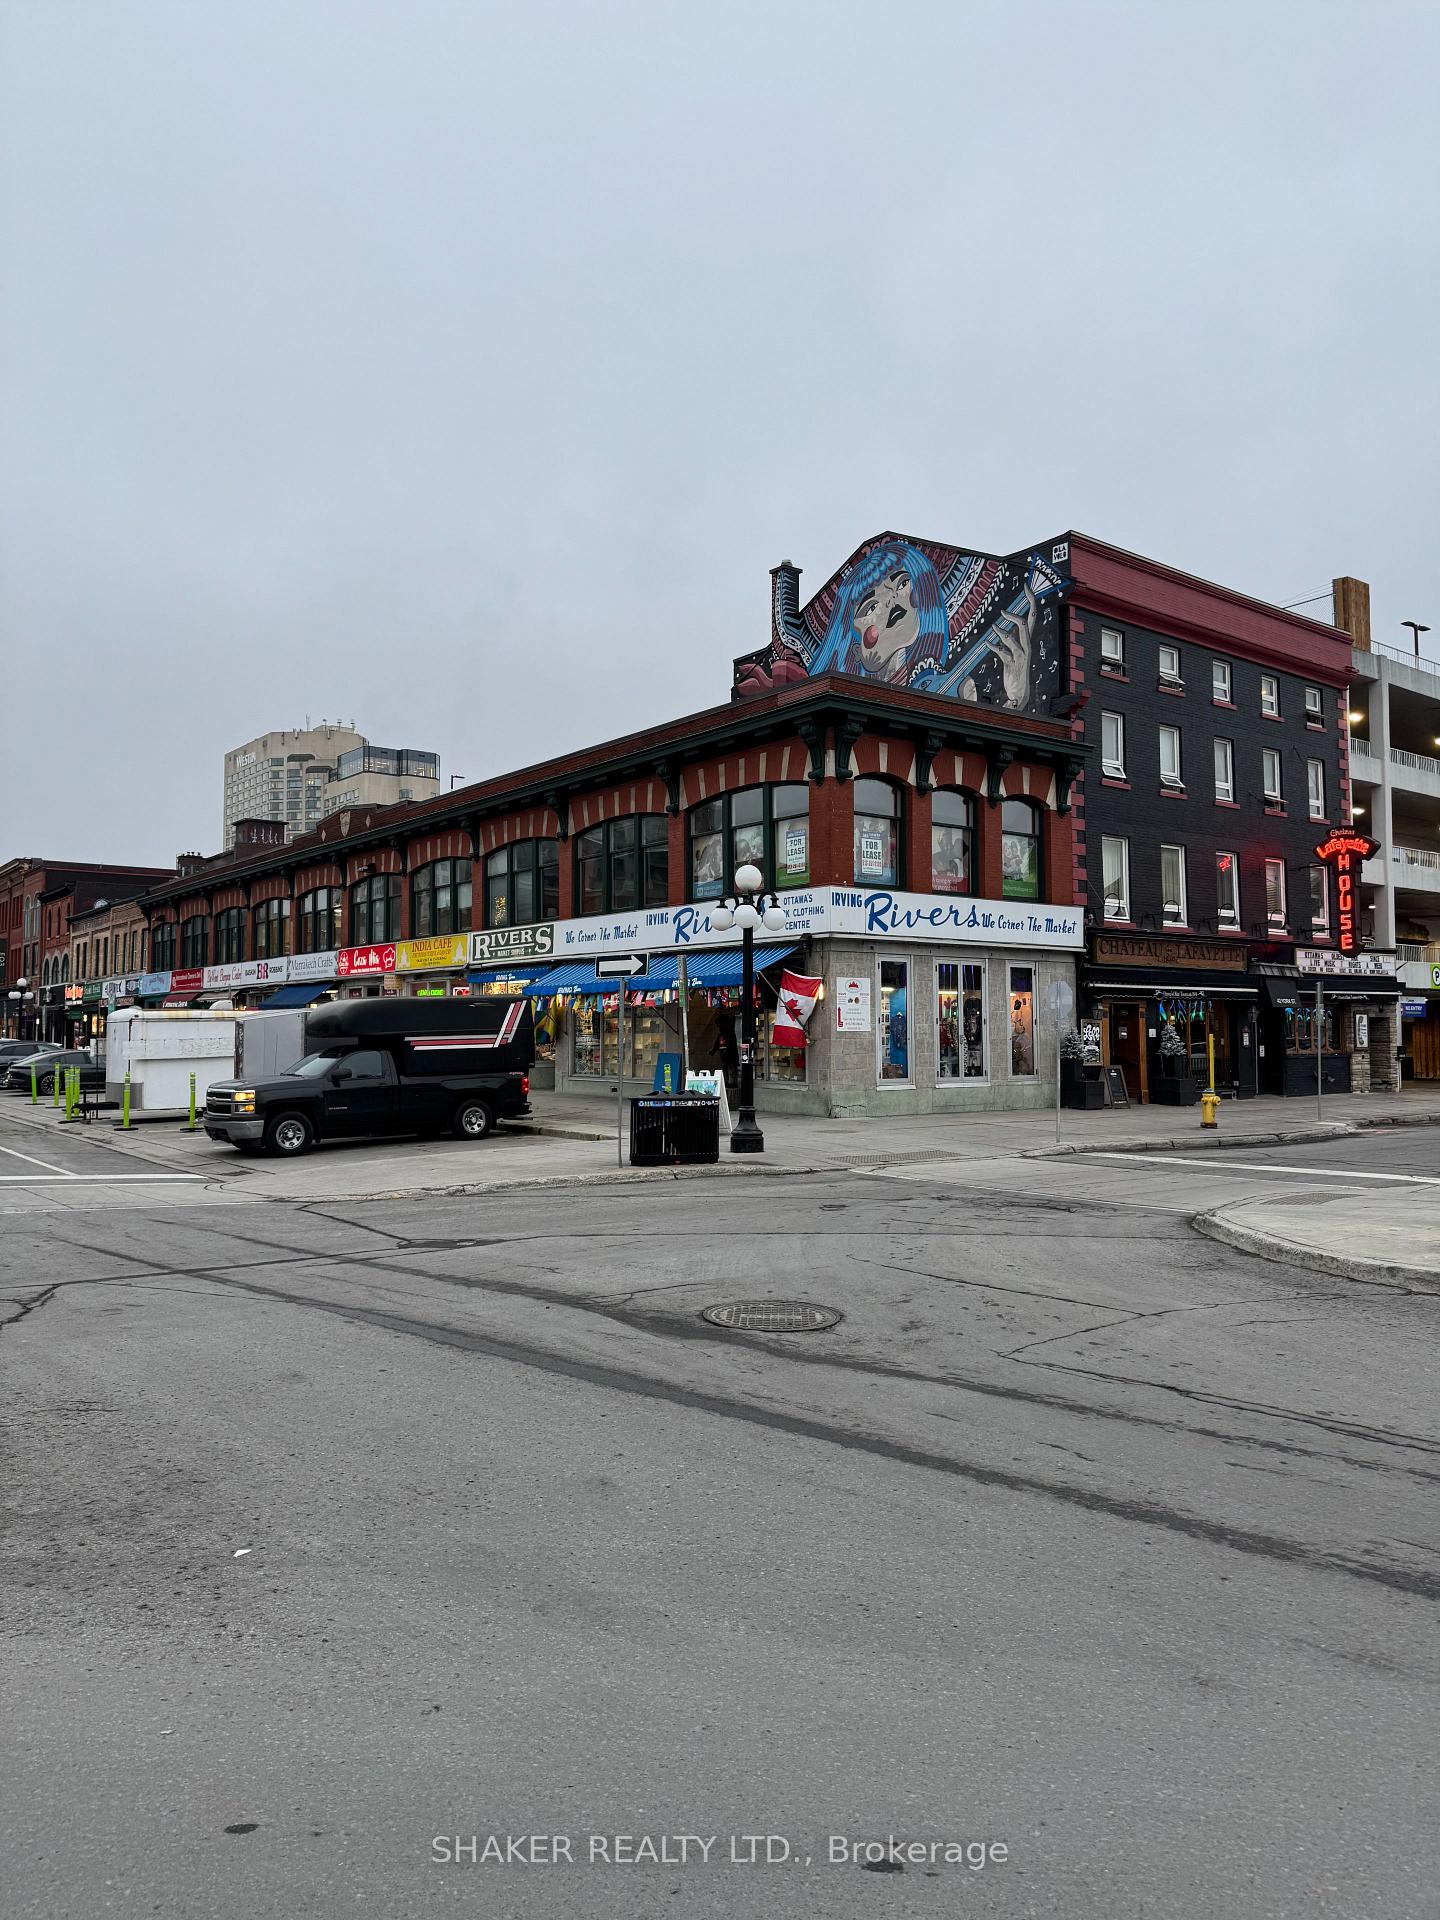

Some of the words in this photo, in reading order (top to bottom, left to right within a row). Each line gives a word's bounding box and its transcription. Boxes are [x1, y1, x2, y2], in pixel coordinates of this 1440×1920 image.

[789, 839, 802, 847] FOR
[865, 840, 878, 850] FOR
[1316, 837, 1370, 859] Lafayette
[787, 846, 805, 857] LEASE
[862, 850, 882, 860] LEASE
[783, 893, 813, 905] OTTAWA'S
[1337, 854, 1353, 950] HOUSE
[792, 906, 825, 918] CLOTHING
[831, 891, 863, 908] IRVING
[864, 892, 980, 933] Rivers
[981, 912, 995, 929] We
[998, 914, 1024, 931] Corner
[1027, 916, 1042, 933] The
[1044, 917, 1077, 935] Market
[565, 930, 575, 944] We
[577, 930, 597, 942] Corner
[599, 927, 611, 941] The
[613, 924, 639, 940] Market
[645, 912, 669, 926] IRVING
[785, 919, 811, 931] CENTRE
[411, 941, 432, 953] INDIA
[433, 938, 452, 950] CAFE
[474, 926, 551, 959] RIVERS
[1176, 943, 1246, 962] LAFAYETTE
[256, 962, 269, 980] BR
[290, 956, 317, 972] Marrakech
[317, 956, 334, 969] Crafts
